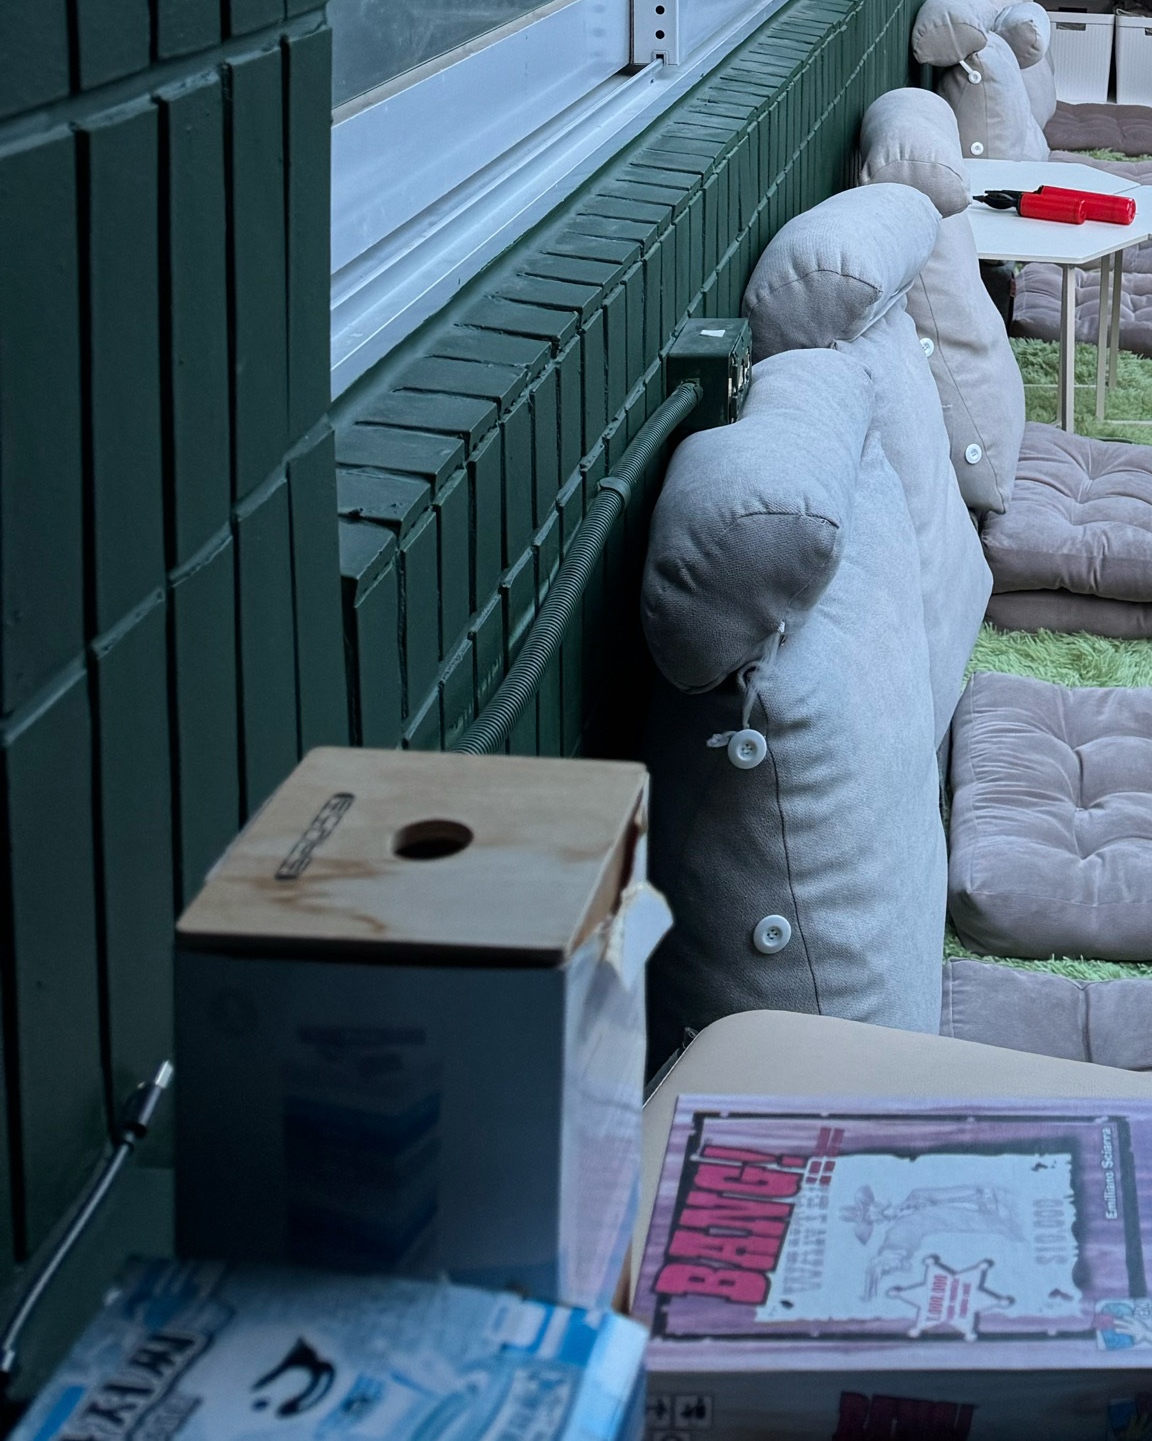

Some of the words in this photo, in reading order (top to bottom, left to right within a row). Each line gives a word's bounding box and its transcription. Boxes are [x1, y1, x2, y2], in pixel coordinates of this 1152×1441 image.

[1101, 1127, 1114, 1169] Sciarra
[1103, 1171, 1118, 1219] Emiliano
[653, 1144, 809, 1305] BANG!
